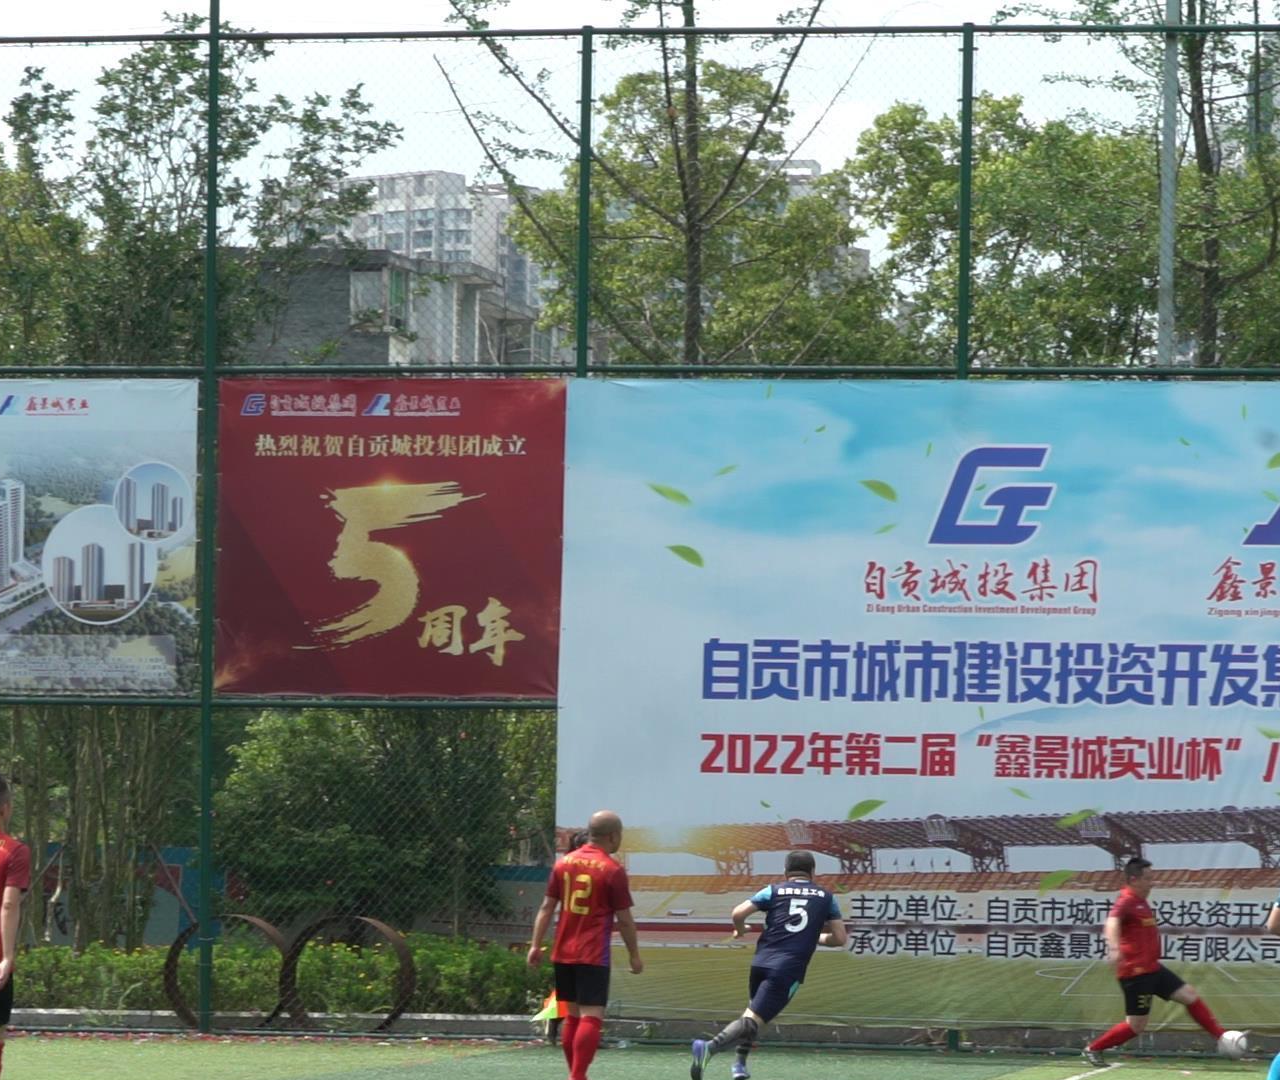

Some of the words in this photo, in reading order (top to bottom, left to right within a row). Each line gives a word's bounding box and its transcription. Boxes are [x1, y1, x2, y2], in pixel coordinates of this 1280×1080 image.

[255, 434, 527, 458] 热烈祝贺自贡城投集团成立
[864, 558, 1099, 604] 自贡城投集团
[922, 604, 973, 614] Construction
[975, 605, 1018, 615] Investment
[1020, 605, 1071, 616] Development
[1207, 607, 1243, 618] Zigong
[417, 597, 525, 667] 周年
[562, 871, 593, 915] 12
[784, 899, 809, 933] 5
